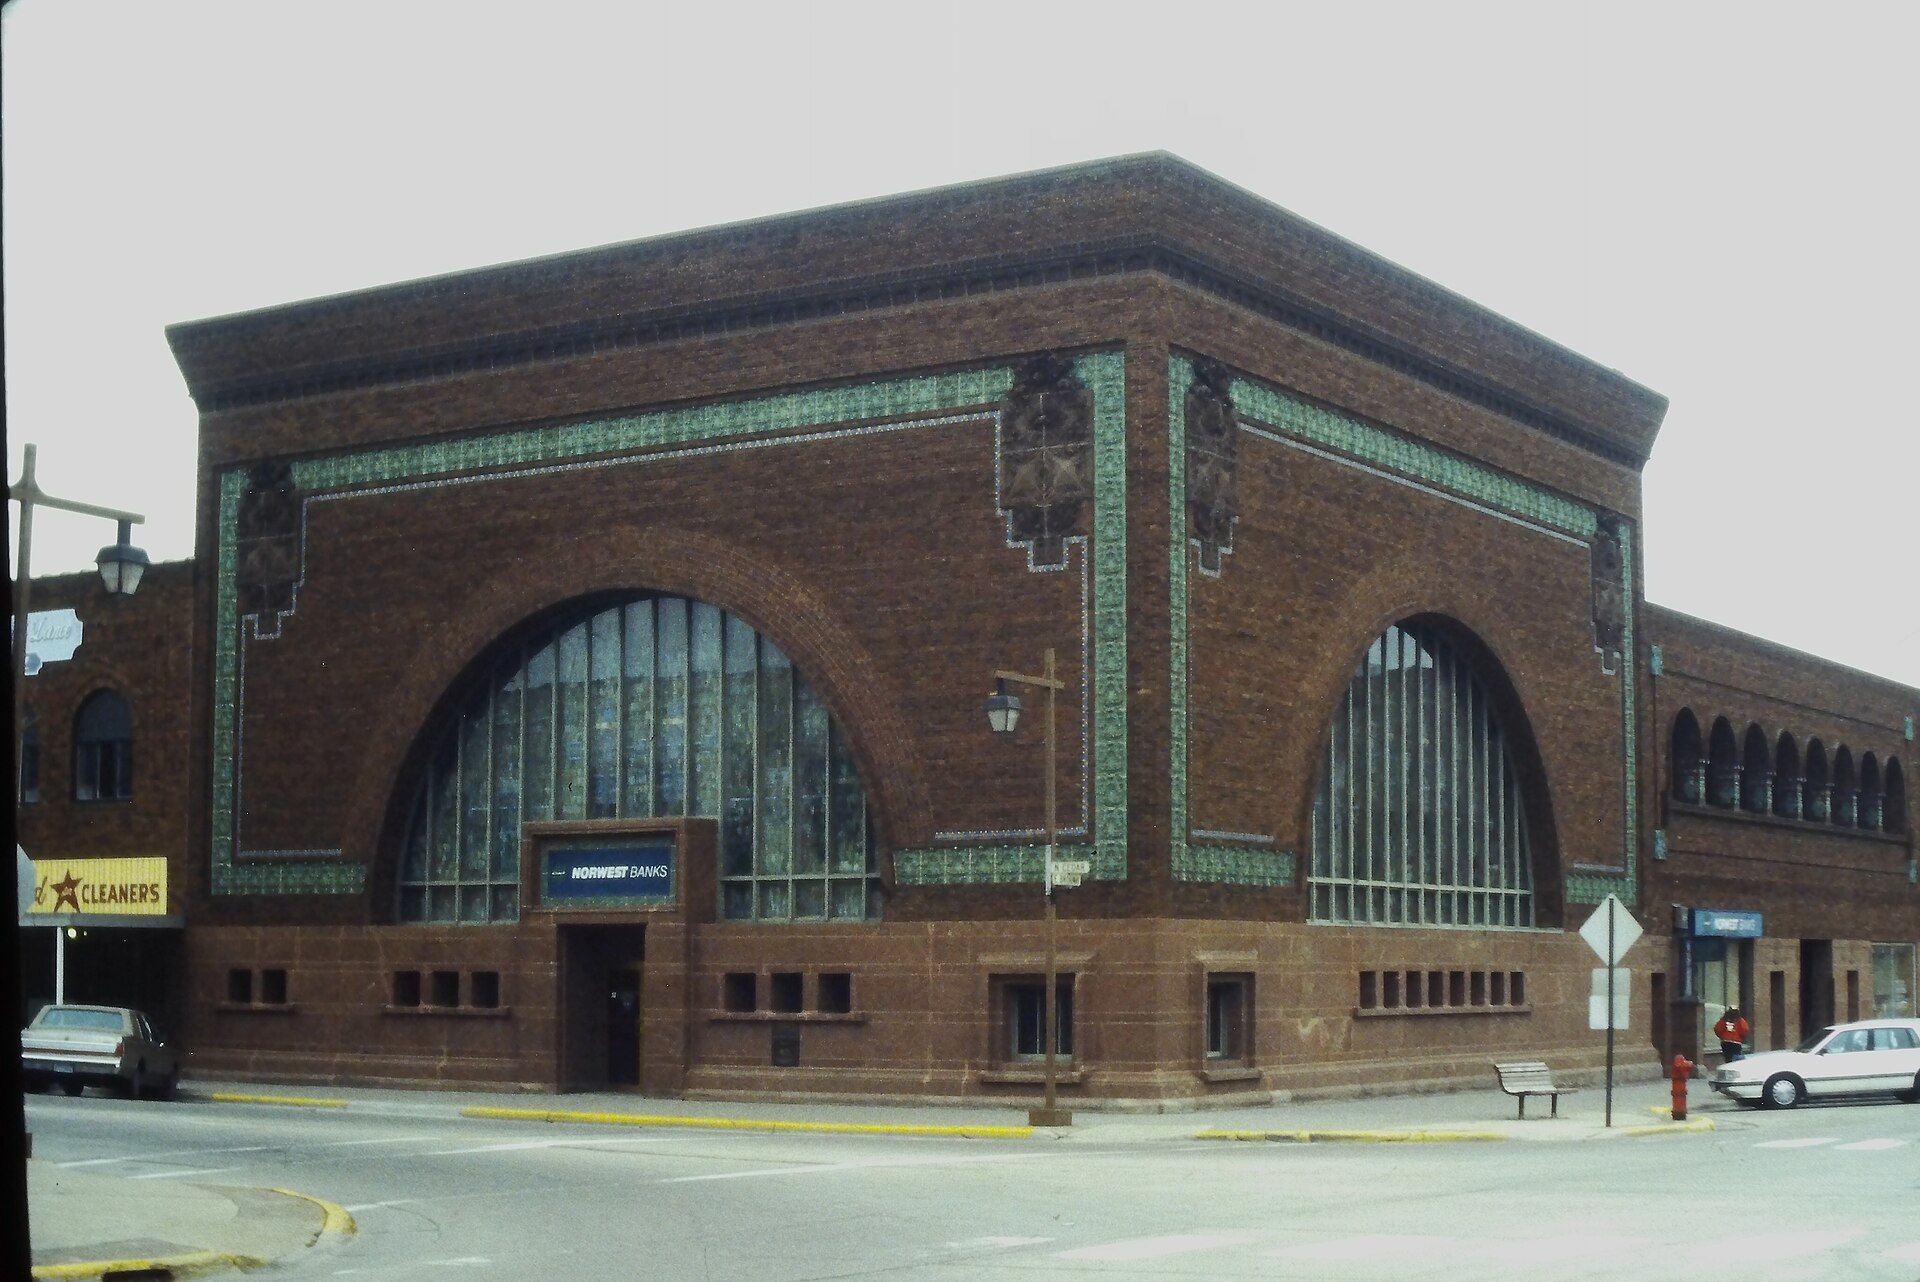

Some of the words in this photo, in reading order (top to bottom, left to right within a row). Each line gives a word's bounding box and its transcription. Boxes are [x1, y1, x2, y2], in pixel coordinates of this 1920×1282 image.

[571, 866, 629, 879] NORWEST
[629, 865, 668, 878] BANKS
[81, 883, 160, 904] CLEANERS
